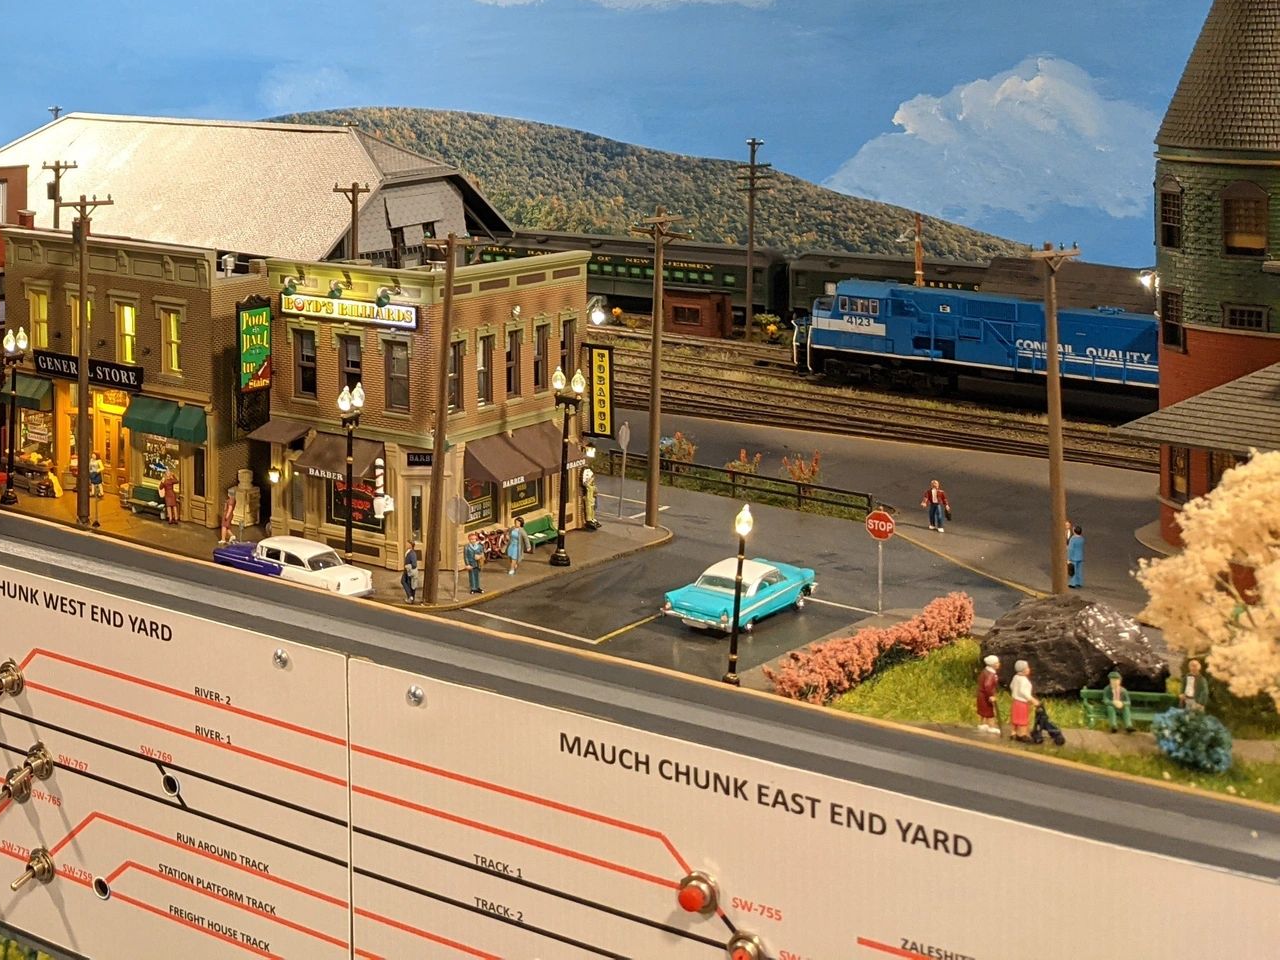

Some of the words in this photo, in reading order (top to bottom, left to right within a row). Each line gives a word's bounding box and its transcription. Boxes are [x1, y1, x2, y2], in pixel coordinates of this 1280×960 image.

[664, 261, 714, 270] JERSEY
[283, 295, 334, 314] BOYD'S
[338, 302, 413, 323] BILLIARDS
[242, 311, 269, 331] POOL
[846, 316, 871, 327] 4123
[242, 330, 269, 353] HALL
[1015, 339, 1074, 356] CONAIL
[1085, 347, 1152, 364] QUALITY
[37, 355, 94, 378] GENERL
[96, 366, 138, 386] STORE
[248, 378, 270, 389] Stairs
[596, 351, 607, 433] TOBACCO
[409, 454, 433, 462] BARB
[308, 467, 344, 481] BARBER
[502, 476, 525, 489] BARBER
[867, 519, 893, 532] STOP
[43, 591, 86, 618] WEST
[91, 605, 124, 629] END
[128, 614, 173, 642] YARD
[225, 696, 231, 706] 2
[226, 735, 232, 745] 1
[58, 754, 89, 772] SW-767
[139, 745, 173, 763] SW-769
[32, 789, 62, 807] SW-765
[559, 731, 651, 775] MAUCH
[658, 759, 749, 801] CHUNK
[757, 783, 821, 819] EAST
[830, 803, 887, 836] END
[895, 818, 973, 858] YARD
[176, 832, 196, 847] RUN
[197, 840, 238, 862] AROUND
[239, 854, 270, 874] TRACK
[62, 863, 93, 881] SW-759
[516, 868, 523, 879] 1
[158, 863, 195, 884] STATION
[196, 877, 244, 903] PLATFORM
[246, 895, 276, 916] TRACK
[516, 911, 524, 922] 2
[731, 896, 783, 921] SW-755
[169, 904, 206, 926] FREIGHT
[207, 920, 238, 940] HOUSE
[240, 932, 271, 952] TRACK
